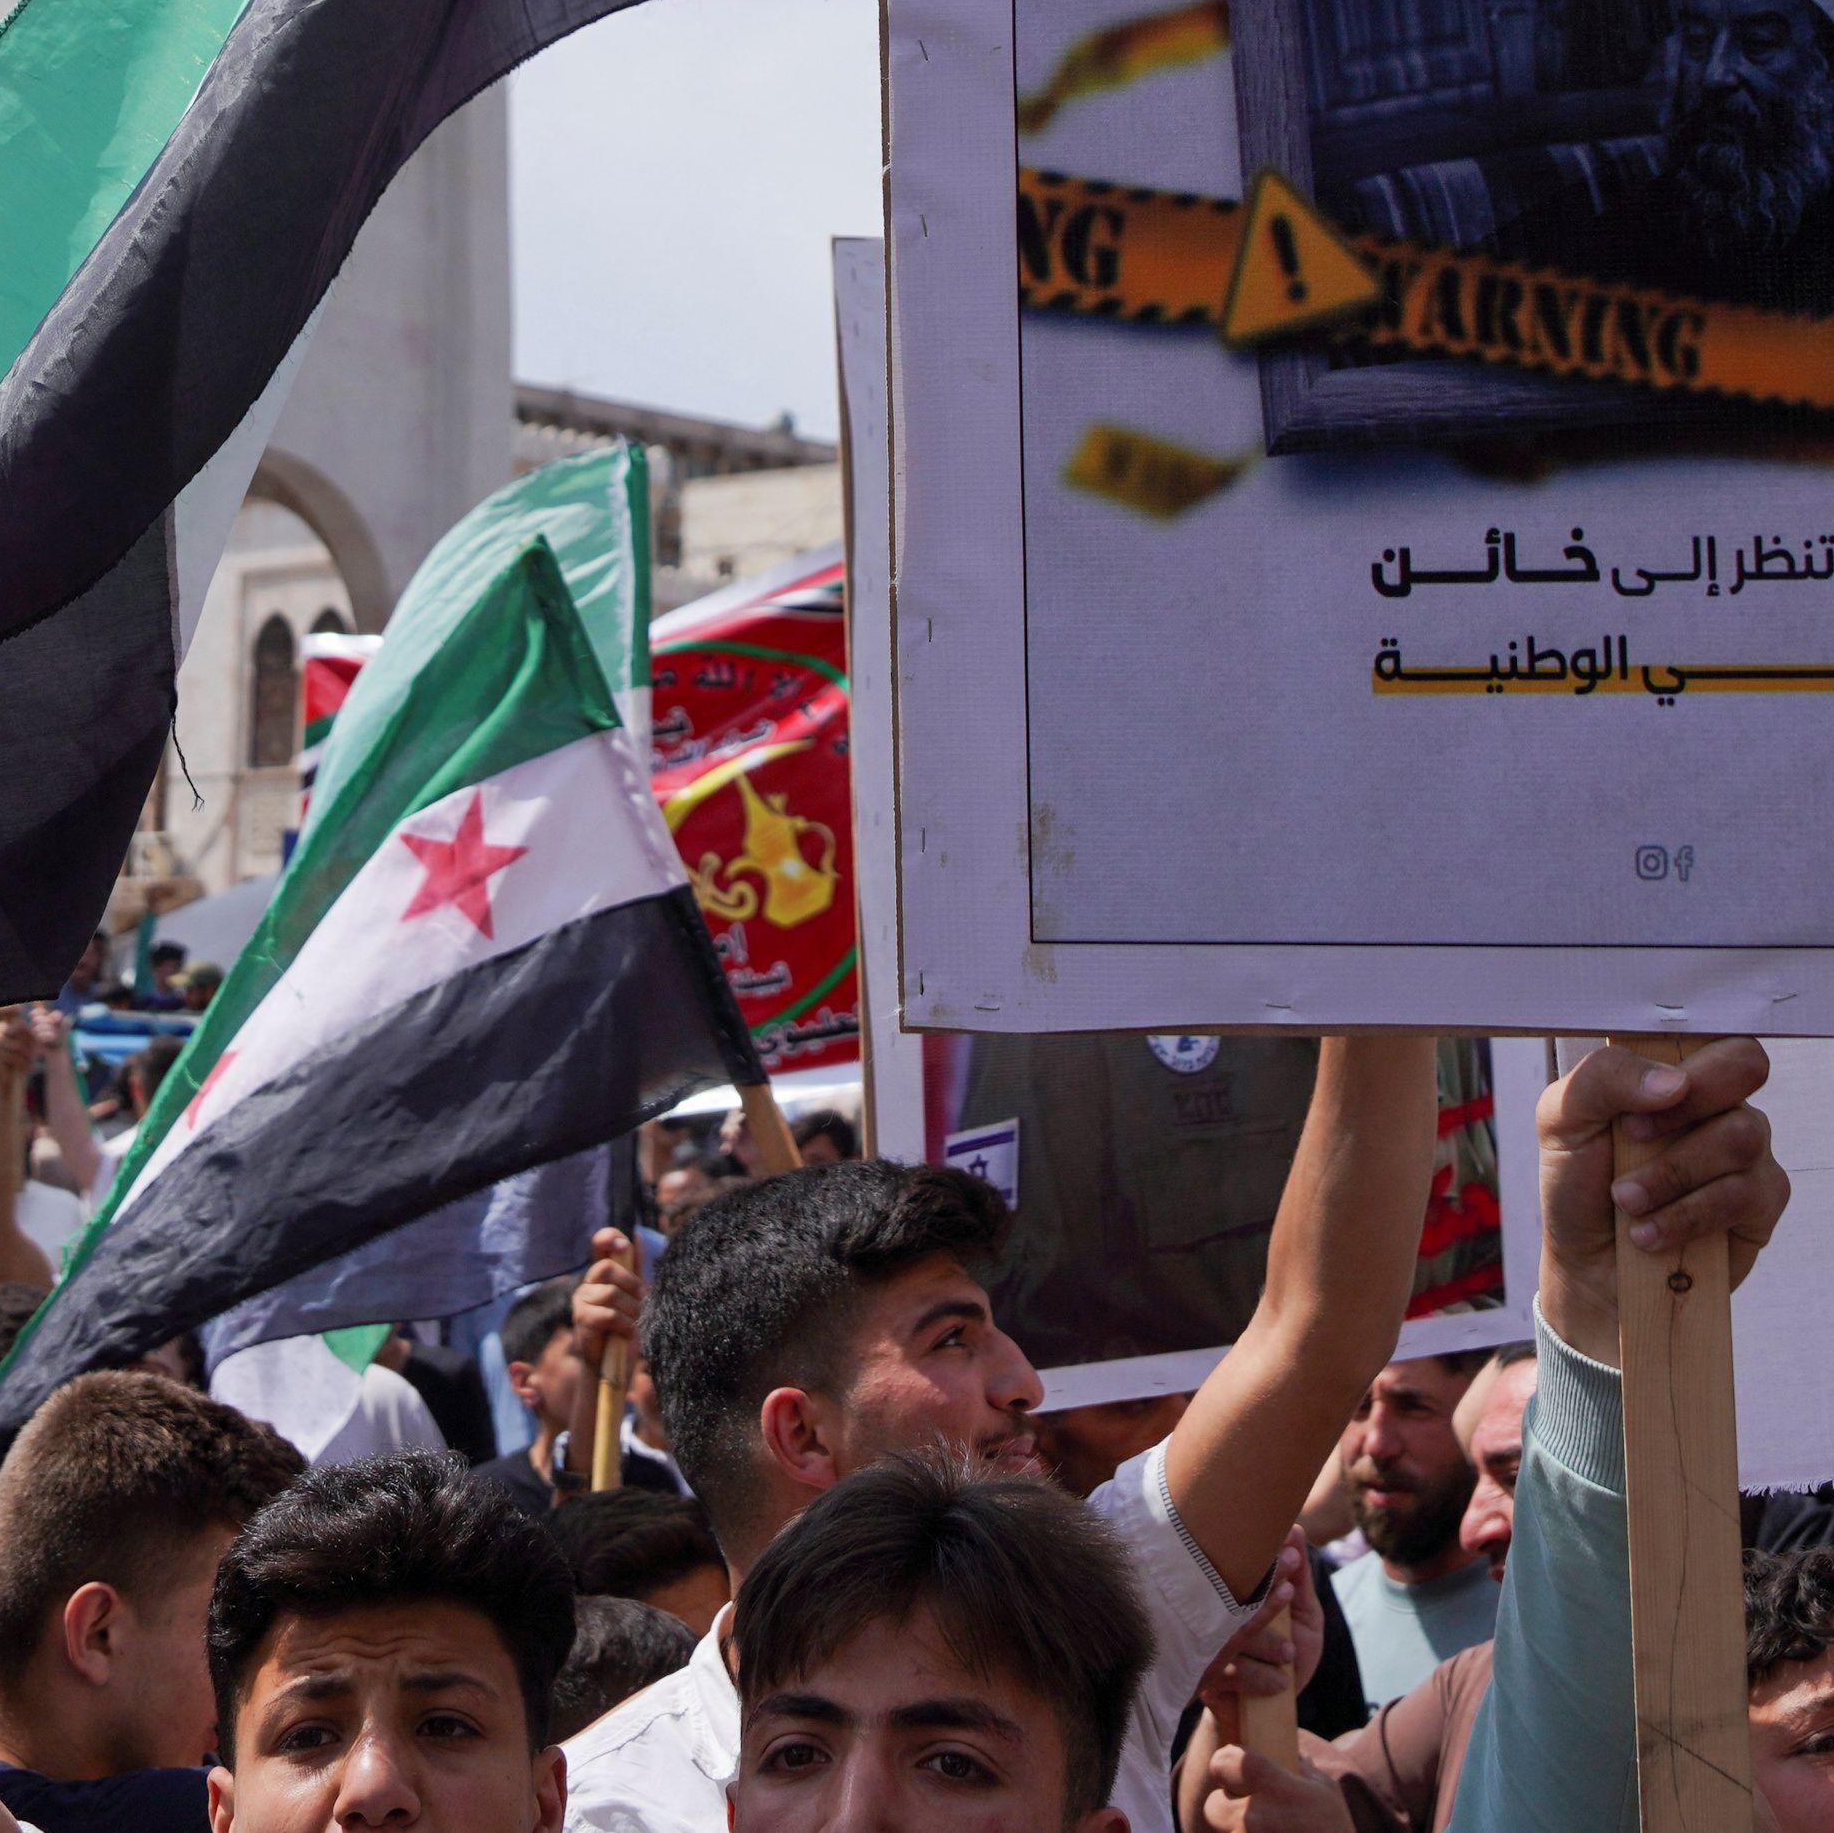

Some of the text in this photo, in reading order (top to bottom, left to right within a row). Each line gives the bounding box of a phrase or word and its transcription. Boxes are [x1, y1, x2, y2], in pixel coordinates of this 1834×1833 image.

[1371, 527, 1601, 598] خائن
[1611, 536, 1718, 597] إلى
[1374, 635, 1629, 696] الوطنية
